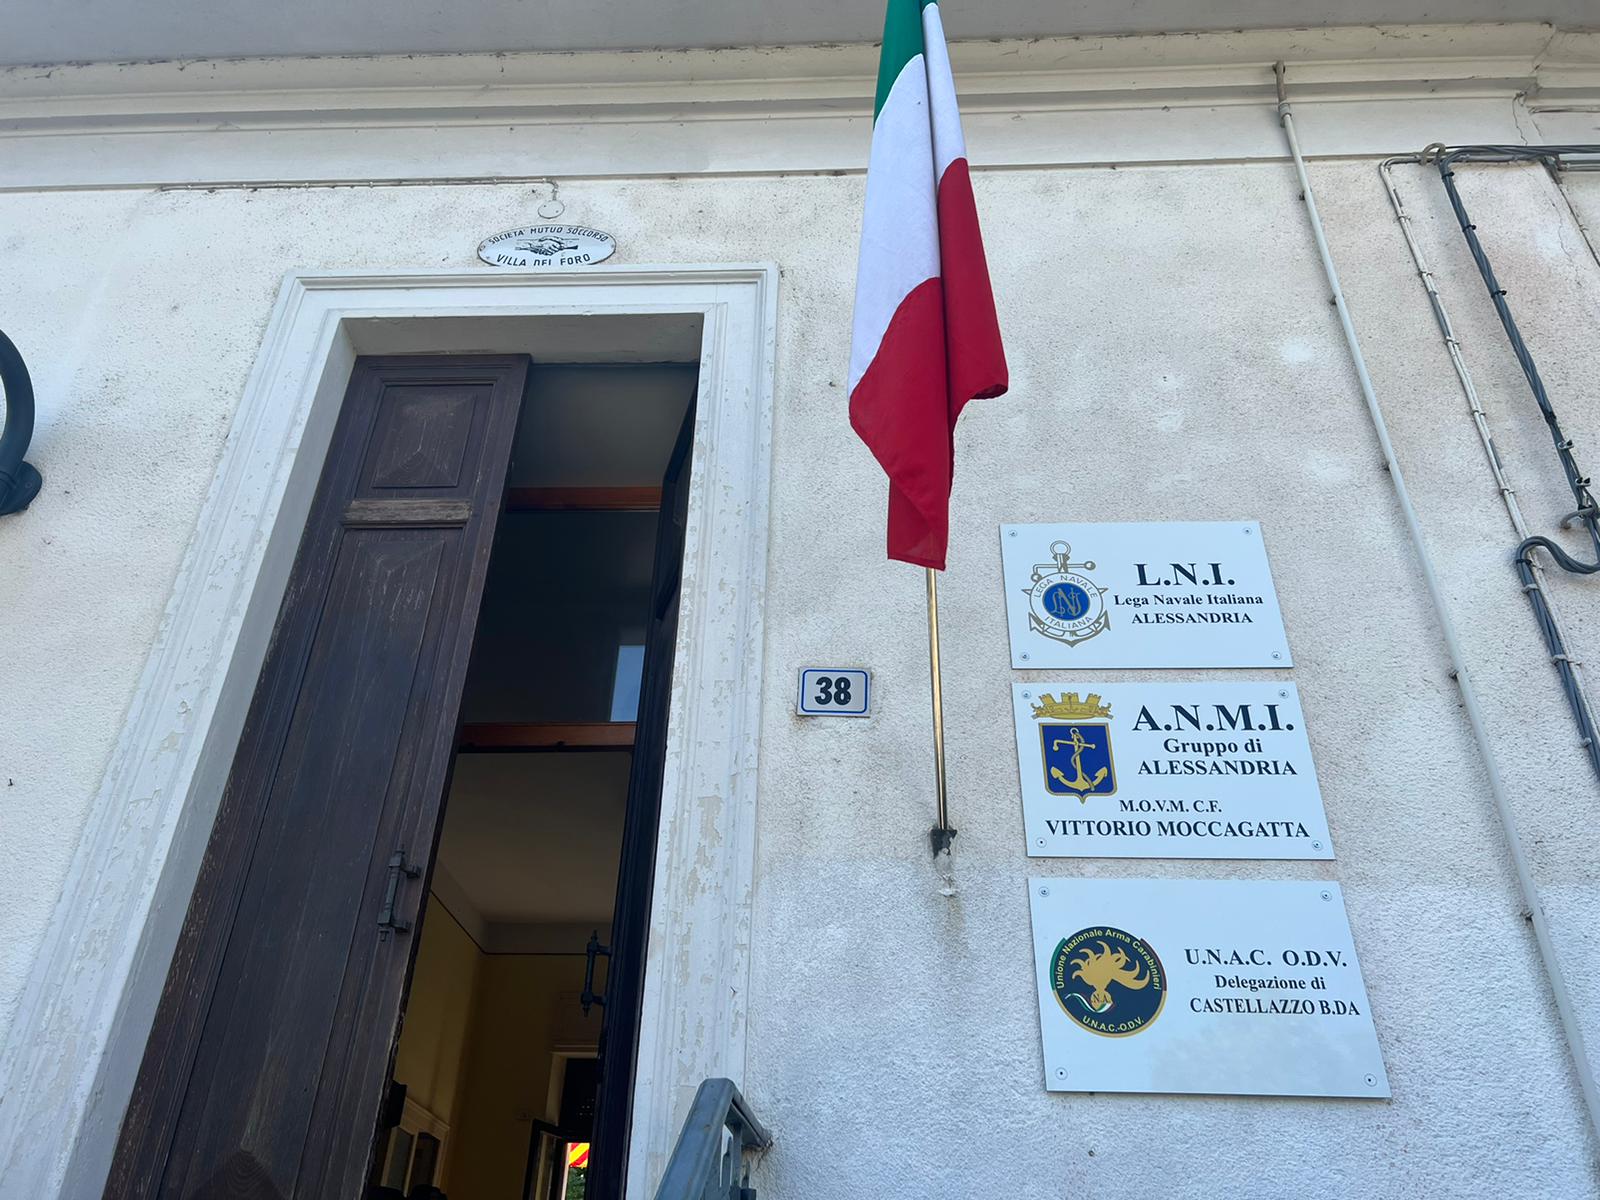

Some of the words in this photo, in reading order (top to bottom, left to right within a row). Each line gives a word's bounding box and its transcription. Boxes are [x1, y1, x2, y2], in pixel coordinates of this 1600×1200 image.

[530, 226, 563, 235] MUTUO
[567, 227, 609, 242] SOCCORSO
[496, 253, 526, 267] VILLA
[560, 253, 591, 266] FORO
[1133, 562, 1235, 586] L.N.I.
[1034, 578, 1054, 598] LEGA
[1060, 574, 1098, 598] NAVALE
[1113, 594, 1149, 607] Lega
[1153, 594, 1203, 606] Navale
[1207, 594, 1263, 605] Italiana
[1044, 616, 1094, 629] ITALIANA
[1131, 612, 1253, 625] ALESSANDRIA
[814, 676, 852, 706] 38
[1132, 703, 1295, 732] A.N.M.I.
[1163, 738, 1238, 757] Gruppo
[1244, 738, 1263, 753] di
[1137, 759, 1298, 776] ALESSANDRIA
[1119, 799, 1190, 813] M.O.V.M.
[1193, 799, 1222, 813] C.F.
[1045, 819, 1151, 837] VITTORIO
[1157, 820, 1310, 838] MOCCAGATTA
[1055, 955, 1067, 989] Unione
[1062, 929, 1103, 955] Nazionale
[1105, 928, 1131, 943] Arma
[1132, 940, 1162, 991] Carabinieri
[1184, 948, 1272, 966] U.N.A.C.
[1282, 949, 1347, 967] O.D.V.
[1215, 974, 1306, 992] Delegazione
[1310, 976, 1326, 990] di
[1189, 997, 1315, 1016] CASTELLAZZO
[1320, 1000, 1361, 1016] B.DA
